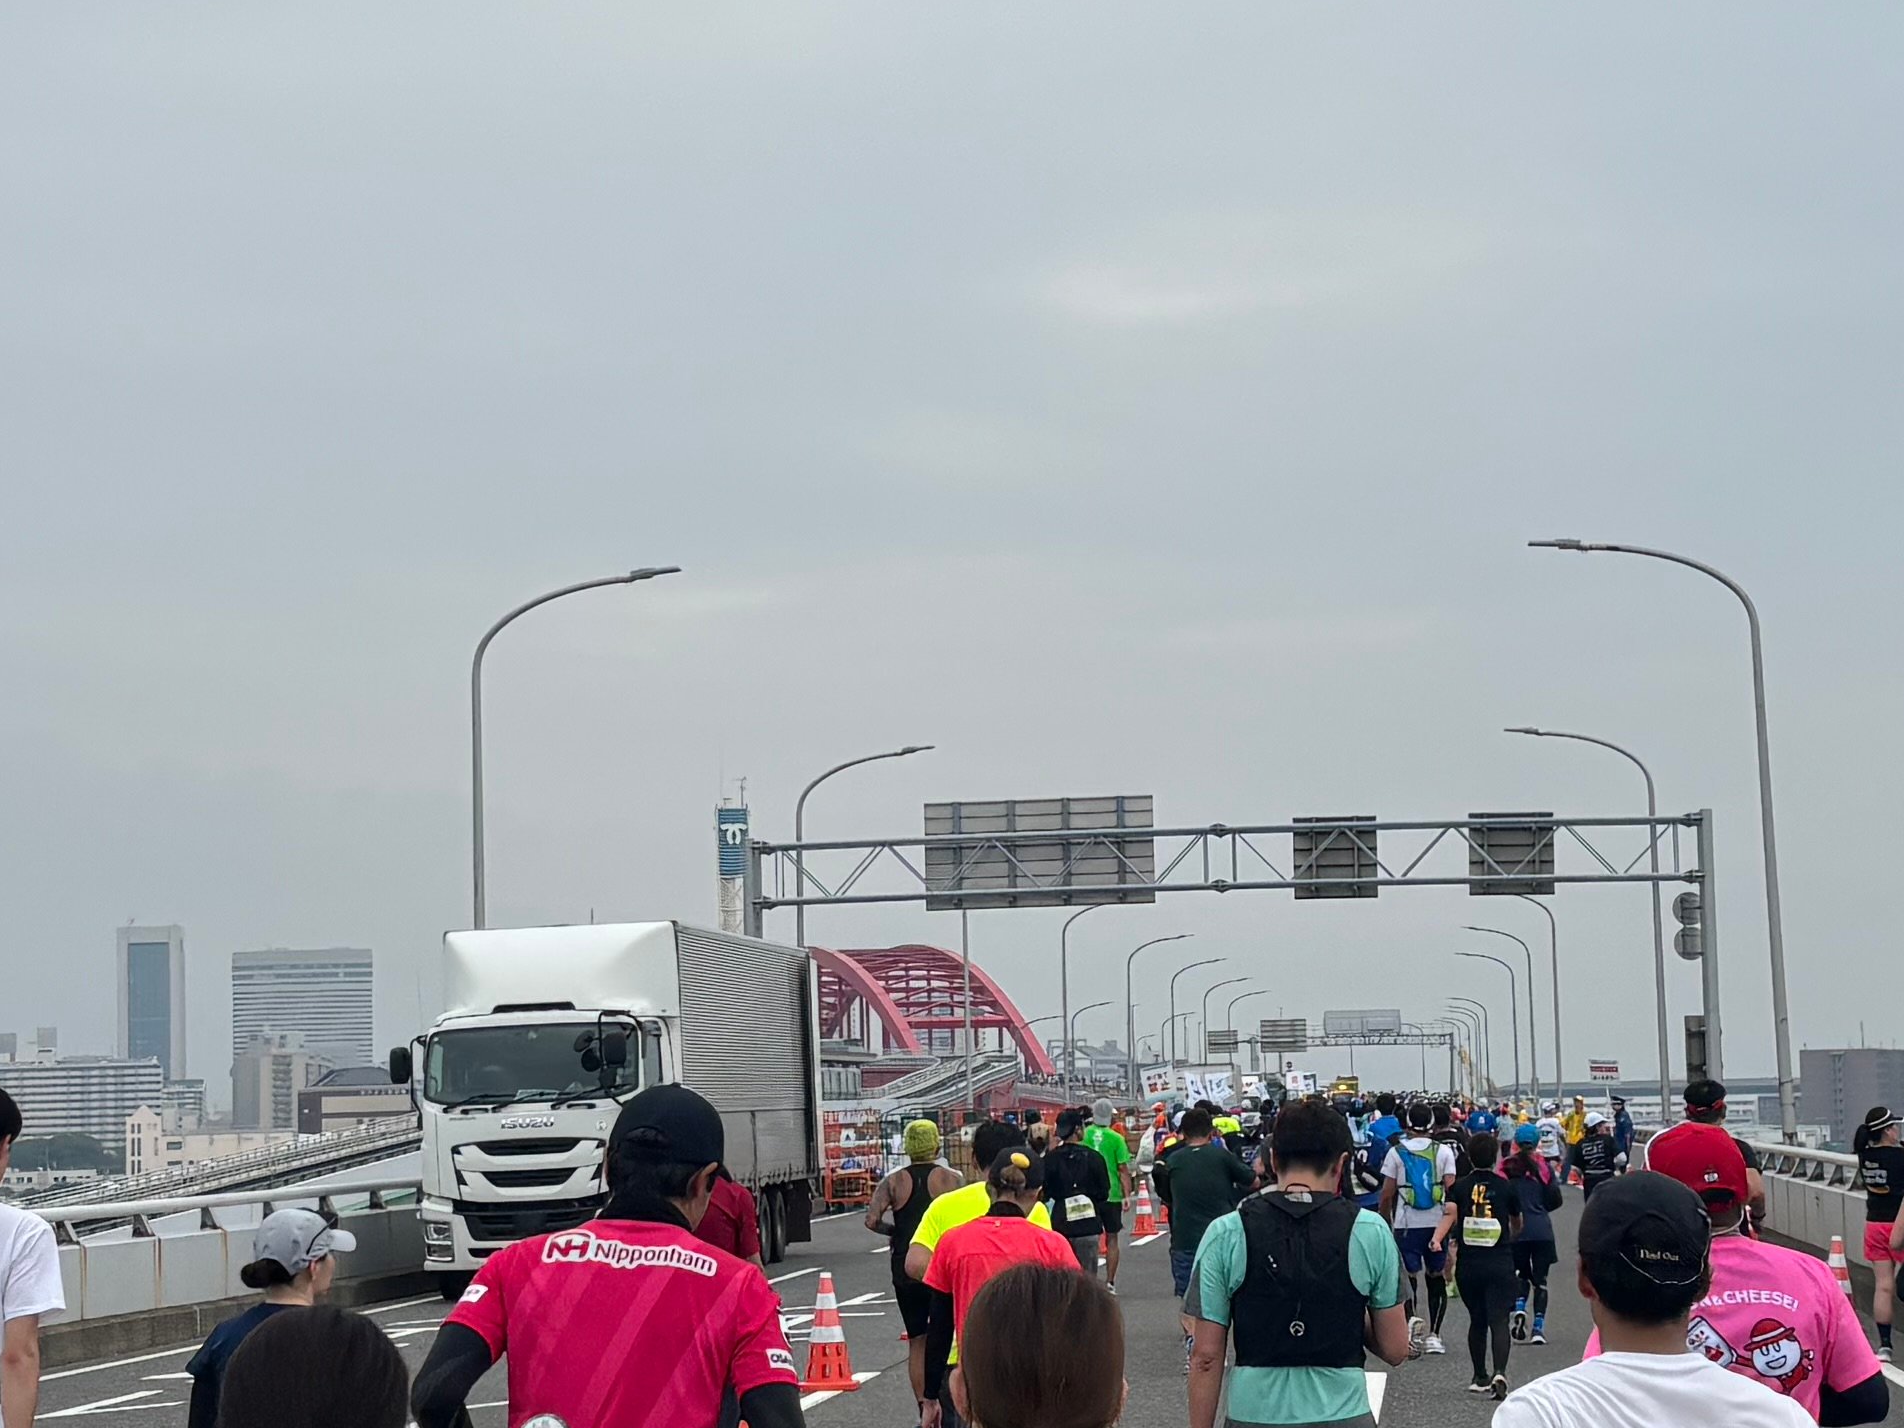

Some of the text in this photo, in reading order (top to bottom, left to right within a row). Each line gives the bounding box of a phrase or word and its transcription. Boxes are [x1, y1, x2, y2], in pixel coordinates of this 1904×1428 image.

[500, 1116, 555, 1130] ISUZU
[595, 1242, 716, 1273] Nipponham
[1691, 1289, 1799, 1312] N&CHEESE!
